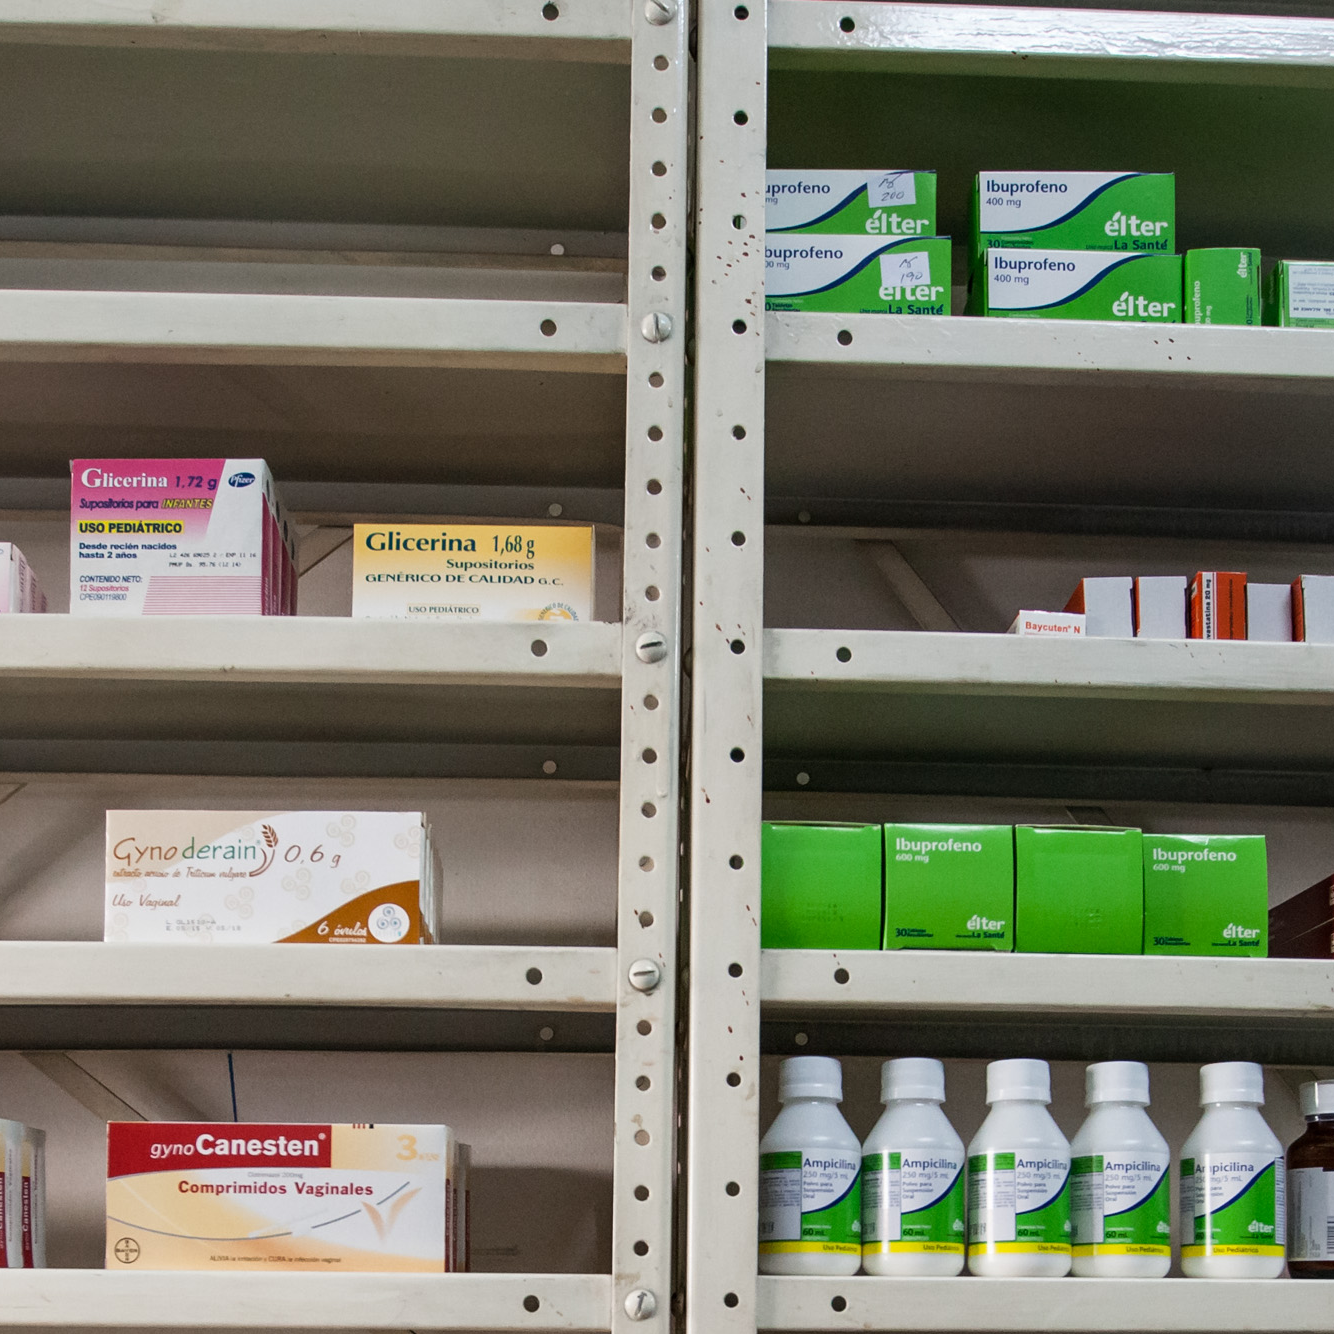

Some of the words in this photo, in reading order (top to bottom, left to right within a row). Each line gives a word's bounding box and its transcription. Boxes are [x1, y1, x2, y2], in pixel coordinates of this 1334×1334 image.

[987, 180, 1067, 196] Ibuprofeno
[882, 191, 904, 201] 200
[1006, 199, 1021, 208] mg
[865, 210, 929, 233] élter
[1105, 212, 1168, 236] élter
[987, 240, 1000, 248] 30
[1114, 240, 1129, 250] La
[1133, 239, 1168, 250] Santé
[994, 256, 1075, 273] Ibuprofeno
[901, 271, 922, 283] 190
[994, 275, 1011, 283] 400
[1014, 276, 1029, 285] mg
[1112, 292, 1175, 317] élter
[81, 468, 167, 488] Glicerina
[175, 476, 203, 489] 1,72
[207, 479, 217, 490] g
[229, 473, 253, 487] Pfizer
[79, 499, 134, 510] Supositorios
[136, 501, 158, 510] para
[161, 499, 213, 509] INFANTES
[79, 523, 105, 533] USO
[109, 521, 182, 533] PEDIÁTRICO
[366, 531, 476, 552] Glicerina
[492, 535, 522, 556] 1,68
[526, 539, 535, 559] g
[446, 559, 535, 571] Supositorios
[80, 575, 120, 583] CONTENIDO
[122, 575, 142, 583] NETO:
[366, 571, 441, 582] GENÉRICO
[446, 574, 465, 583] DE
[468, 575, 535, 584] CALIDAD
[80, 584, 87, 592] 12
[89, 584, 129, 592] Supositorios
[429, 605, 479, 614] PEDIÁTRICO
[1025, 621, 1067, 633] Baycuten
[1074, 626, 1080, 634] N
[896, 838, 982, 854] Ibuprofeno
[284, 845, 324, 864] 0,6
[331, 854, 341, 868] g
[915, 855, 929, 863] mg
[1153, 848, 1237, 864] Ibuprofeno
[1171, 865, 1186, 873] mg
[113, 894, 133, 906] Uso
[140, 894, 180, 908] Vaginal
[317, 922, 329, 935] 6
[334, 921, 367, 936] óvulos
[967, 915, 1005, 930] élter
[896, 928, 907, 937] 30
[1223, 923, 1260, 938] élter
[1153, 937, 1164, 946] 30
[396, 1134, 418, 1161] 3
[803, 1158, 856, 1171] Ampicilina
[902, 1159, 957, 1171] Ampicilina
[1105, 1162, 1160, 1173] Ampicilina
[178, 1180, 286, 1196] Comprimidos
[295, 1182, 374, 1197] Vaginales
[1248, 1220, 1274, 1233] élter
